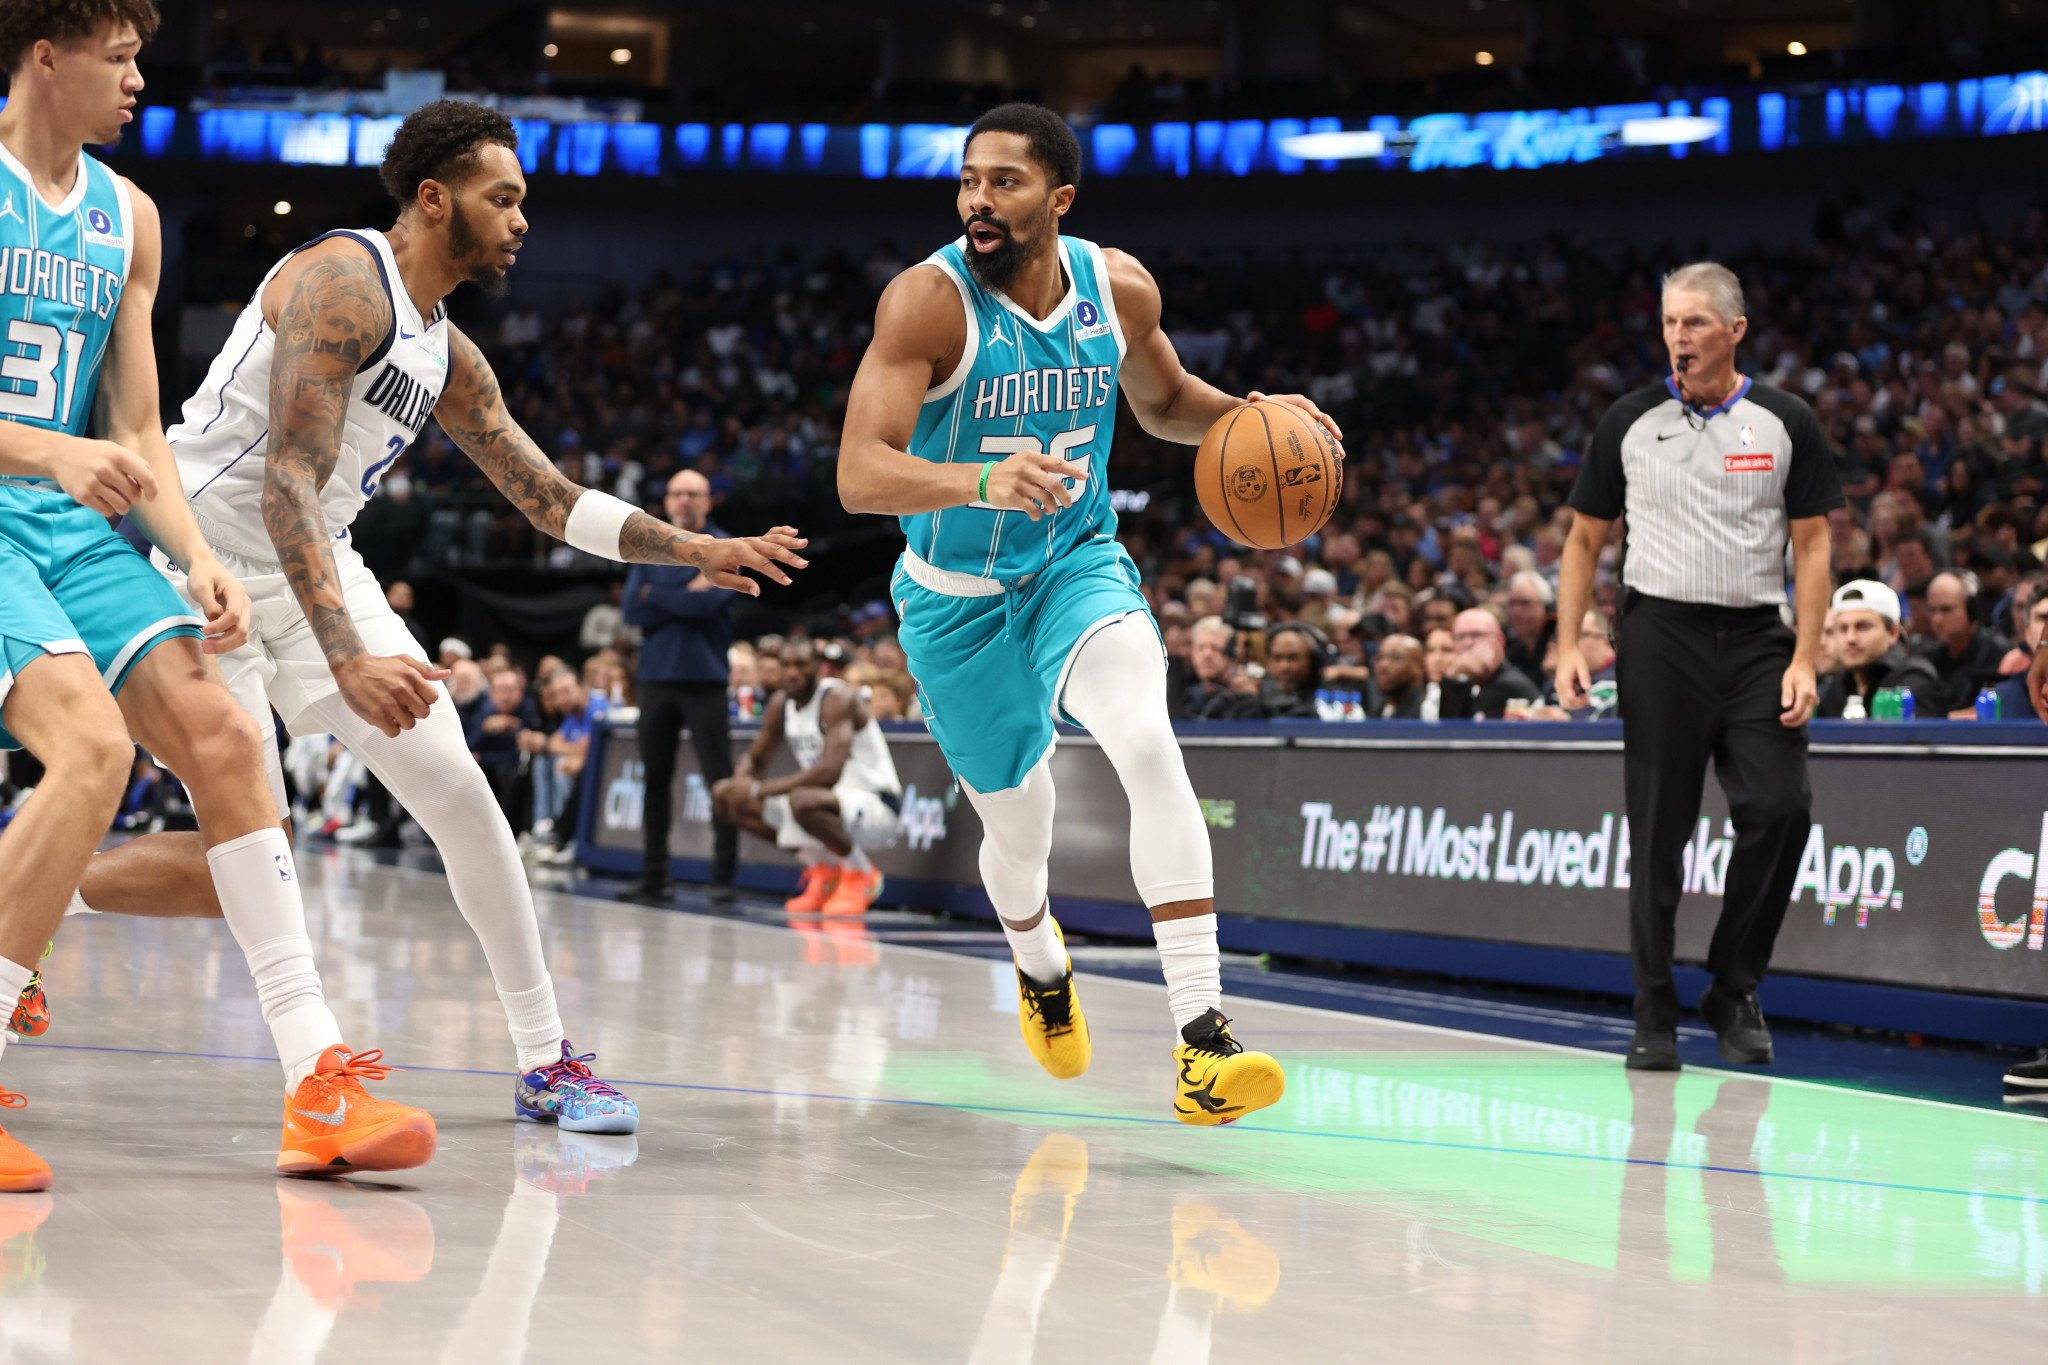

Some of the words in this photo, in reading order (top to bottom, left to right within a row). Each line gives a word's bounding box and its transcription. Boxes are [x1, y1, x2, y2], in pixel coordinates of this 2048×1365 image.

[0, 319, 87, 426] 31
[972, 365, 1112, 420] HORNETS
[360, 434, 408, 498] 2
[1725, 457, 1773, 469] Emirates
[1300, 801, 1359, 872] The
[1360, 804, 1405, 875] #1
[1402, 805, 1496, 881] Most
[1494, 809, 1614, 888] Loved
